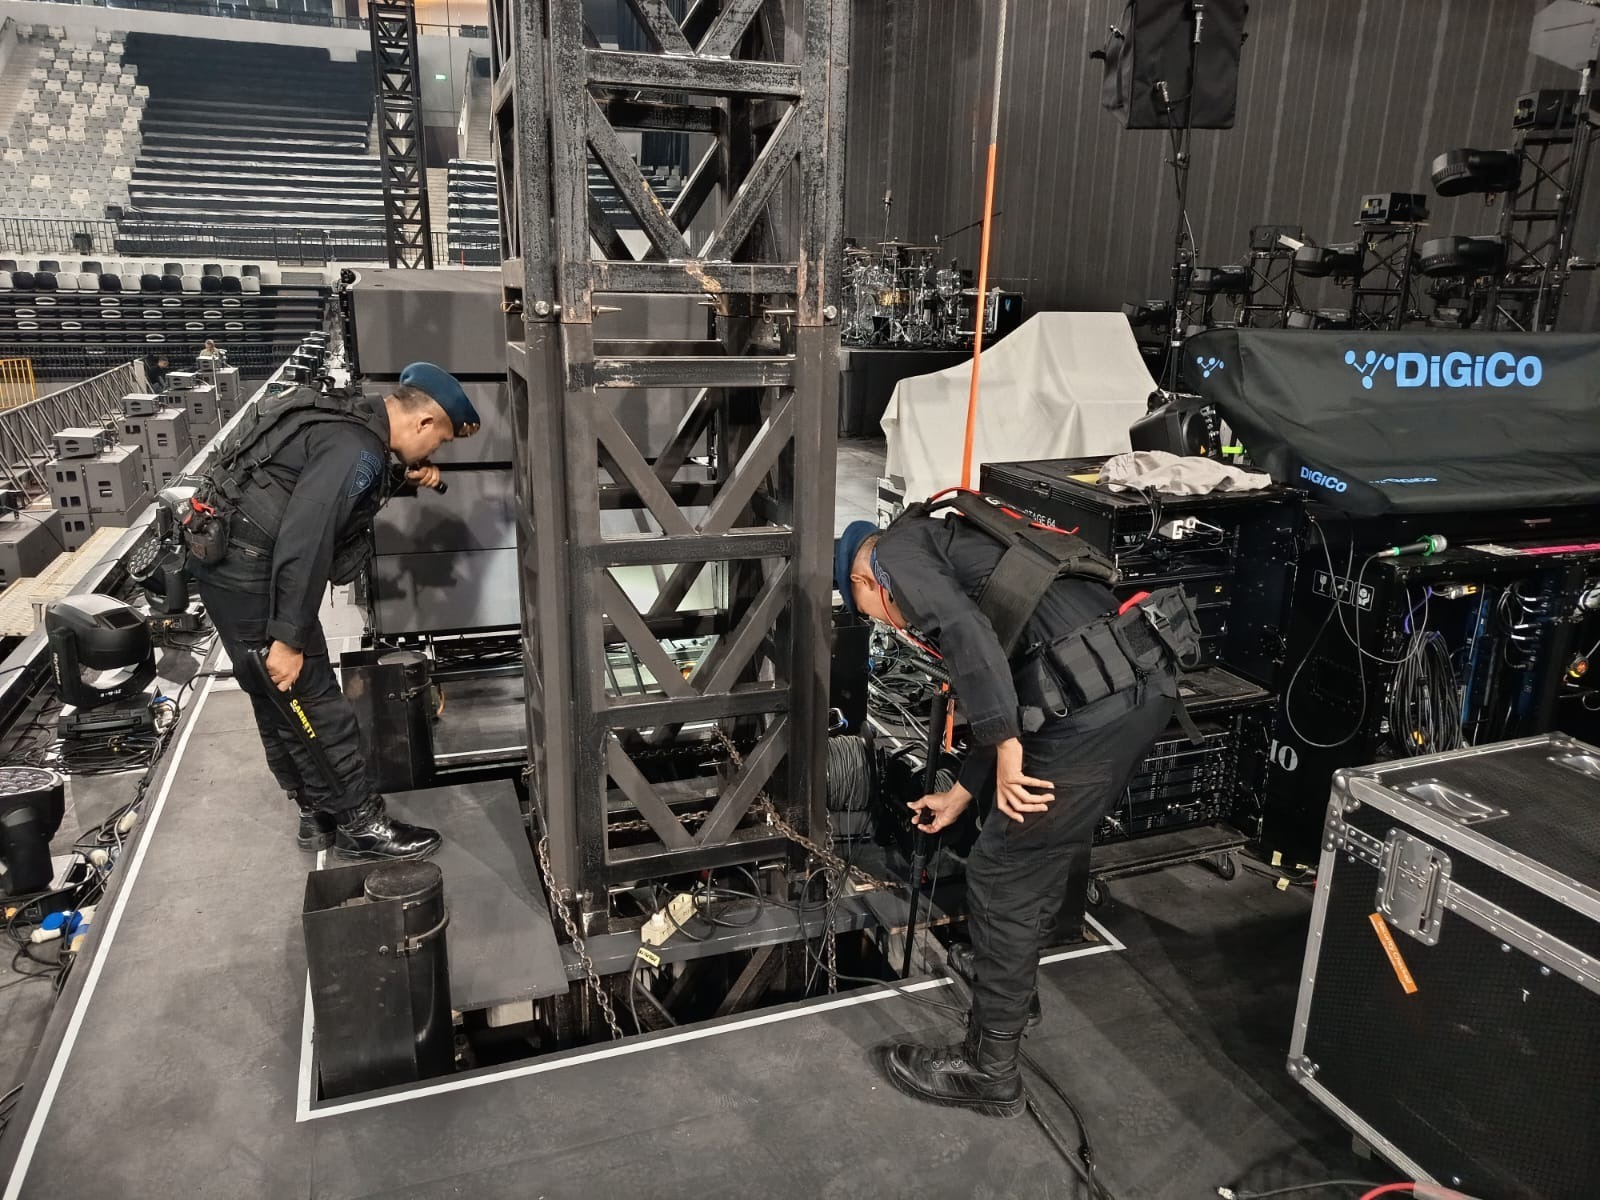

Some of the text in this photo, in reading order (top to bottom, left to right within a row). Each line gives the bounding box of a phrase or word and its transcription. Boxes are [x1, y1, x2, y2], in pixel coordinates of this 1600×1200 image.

[1396, 351, 1543, 388] DiGiCo
[1300, 466, 1348, 493] DiGiCo
[292, 699, 316, 739] GARRETT
